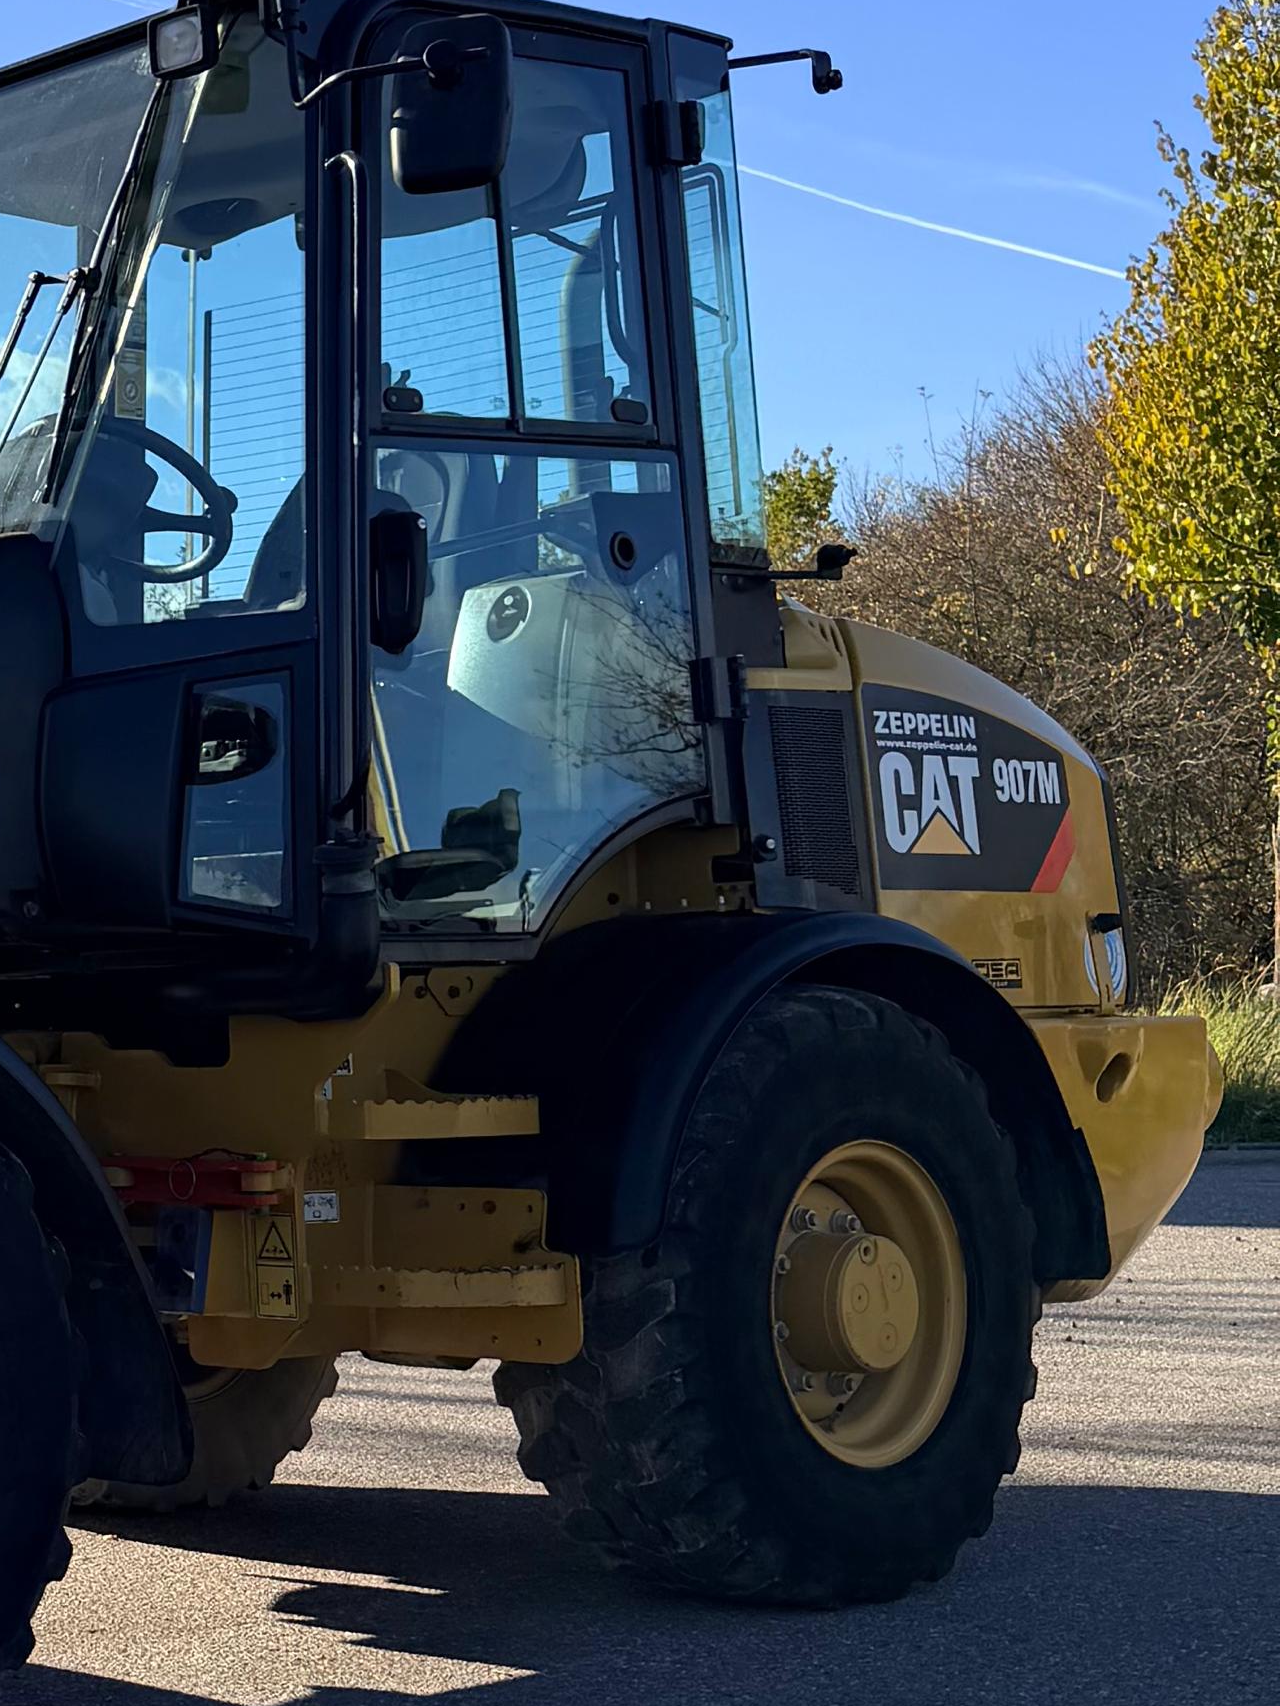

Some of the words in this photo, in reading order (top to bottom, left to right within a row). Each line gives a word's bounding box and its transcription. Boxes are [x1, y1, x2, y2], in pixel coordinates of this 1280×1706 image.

[872, 710, 977, 739] ZEPPELIN
[878, 751, 982, 856] CAT
[992, 758, 1062, 805] 907M
